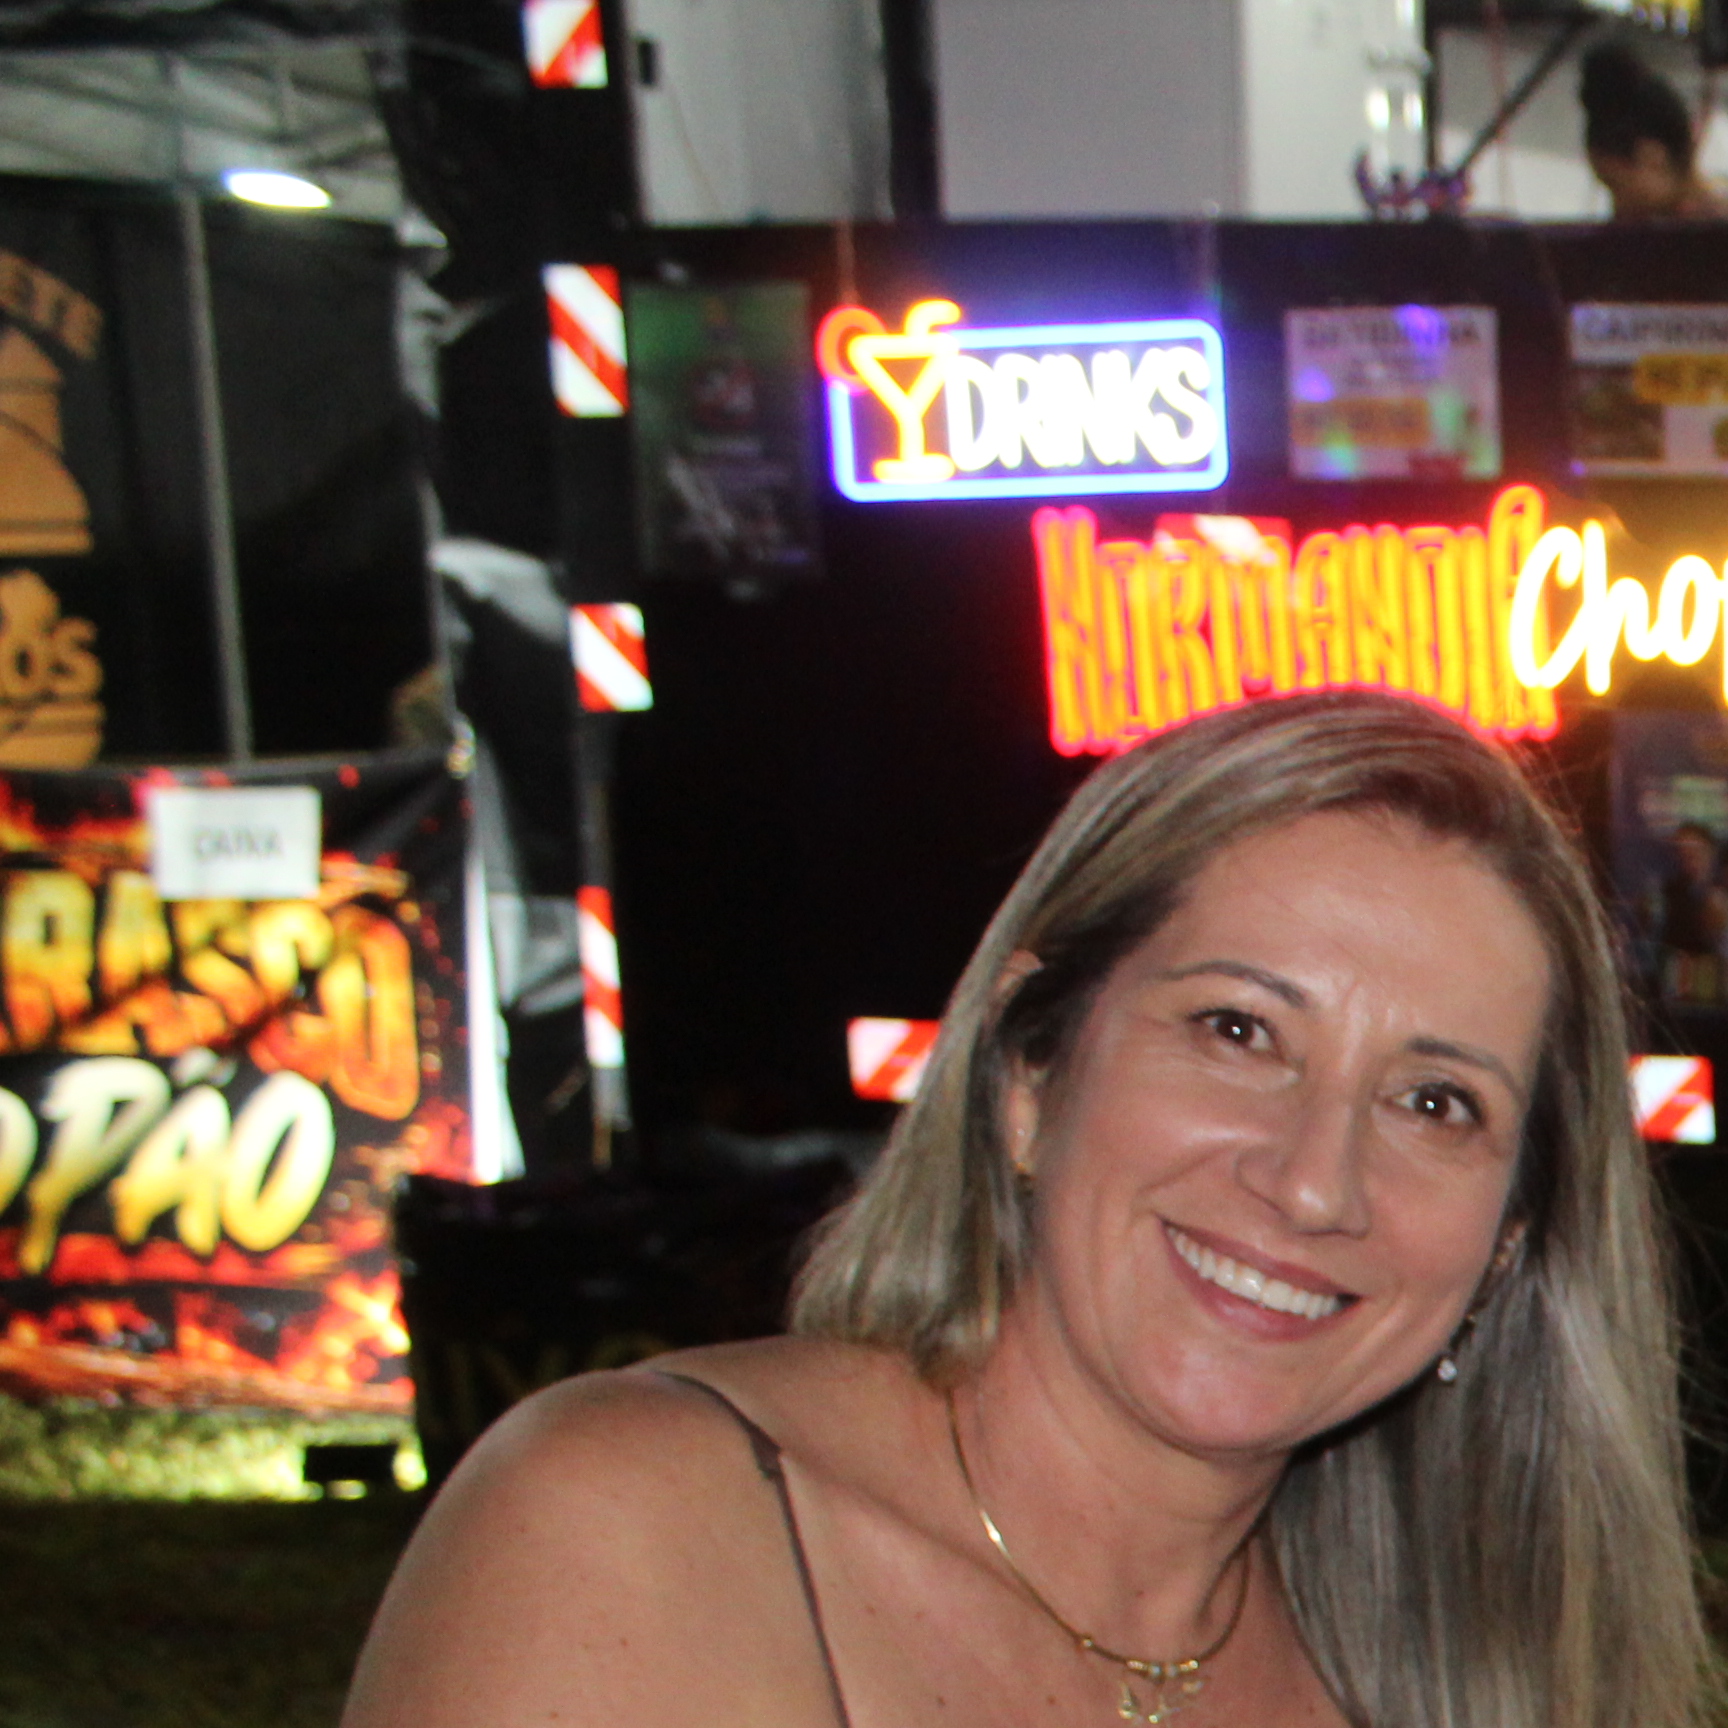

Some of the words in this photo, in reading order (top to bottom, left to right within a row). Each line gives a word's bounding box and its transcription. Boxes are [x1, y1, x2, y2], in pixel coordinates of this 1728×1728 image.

[193, 827, 285, 861] CAIXA
[0, 868, 420, 1120] RASCO
[19, 1047, 335, 1275] PÃO
